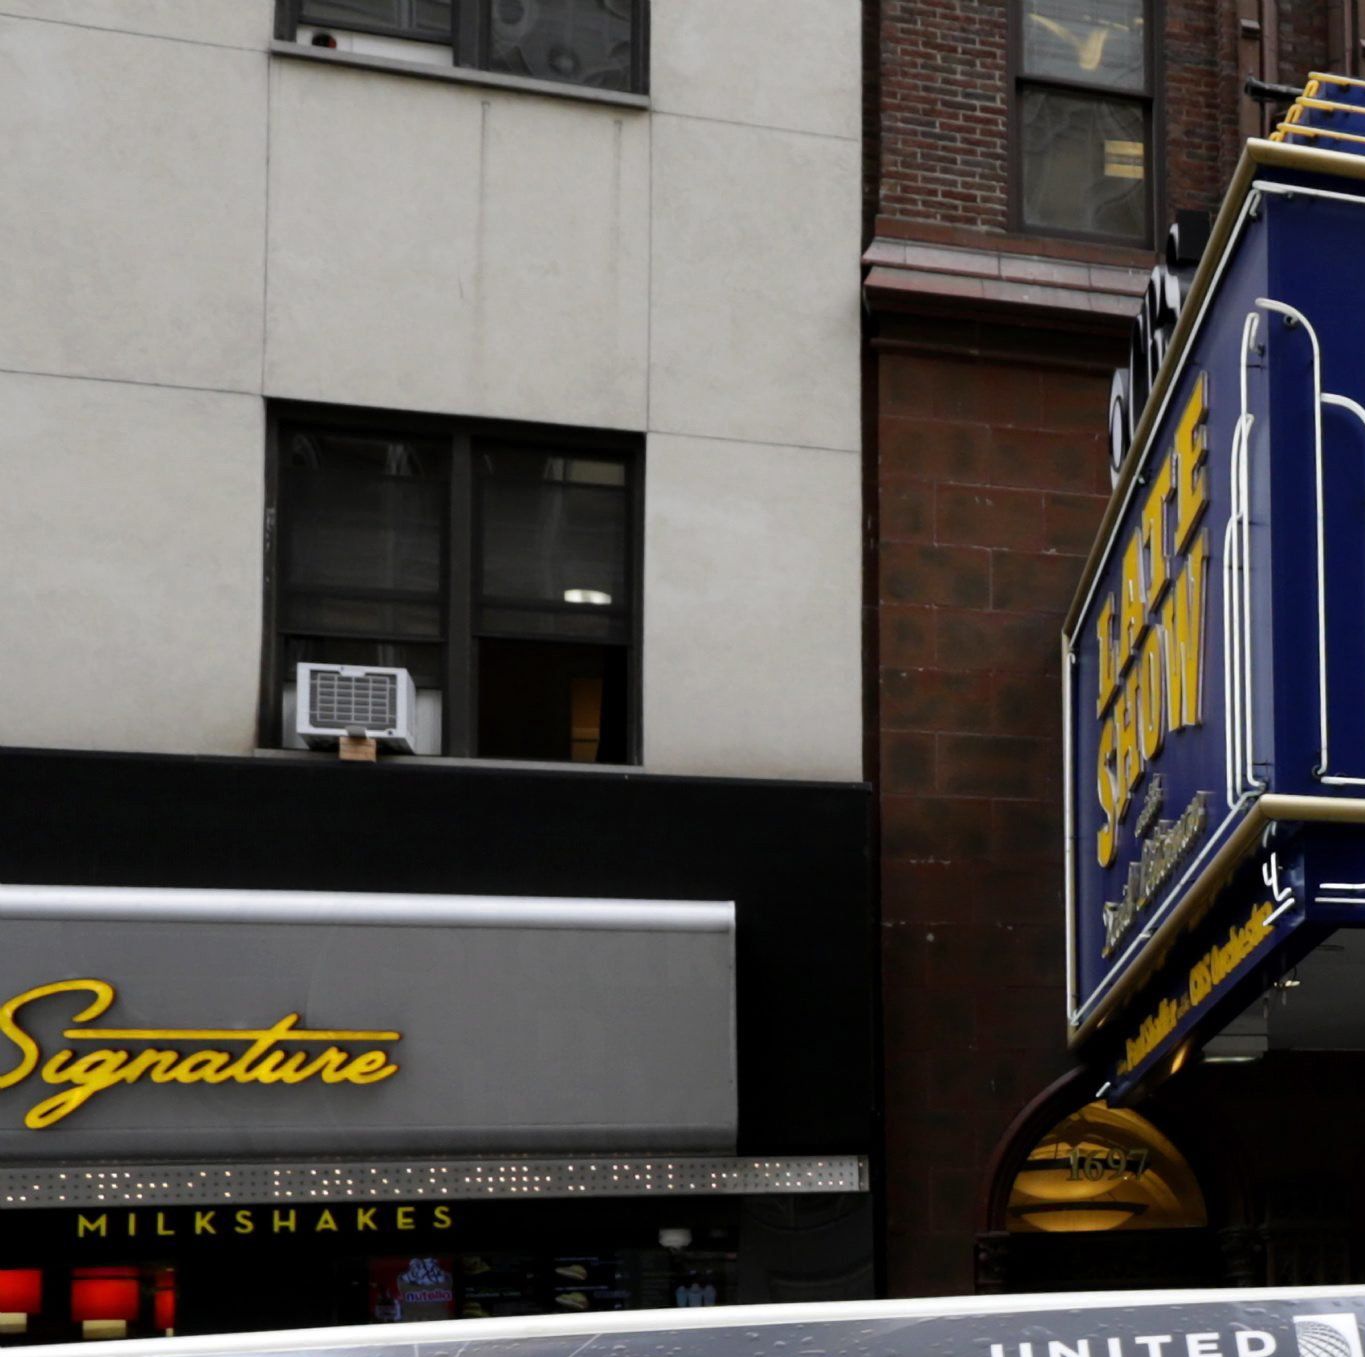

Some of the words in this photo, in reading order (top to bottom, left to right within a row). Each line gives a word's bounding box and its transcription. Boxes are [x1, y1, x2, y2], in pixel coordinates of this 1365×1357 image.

[1096, 369, 1209, 720] LATE
[1096, 526, 1210, 870] SHOW
[0, 978, 402, 1130] Signature
[77, 1205, 453, 1238] MILKSHAKES
[1066, 1148, 1150, 1182] 1697
